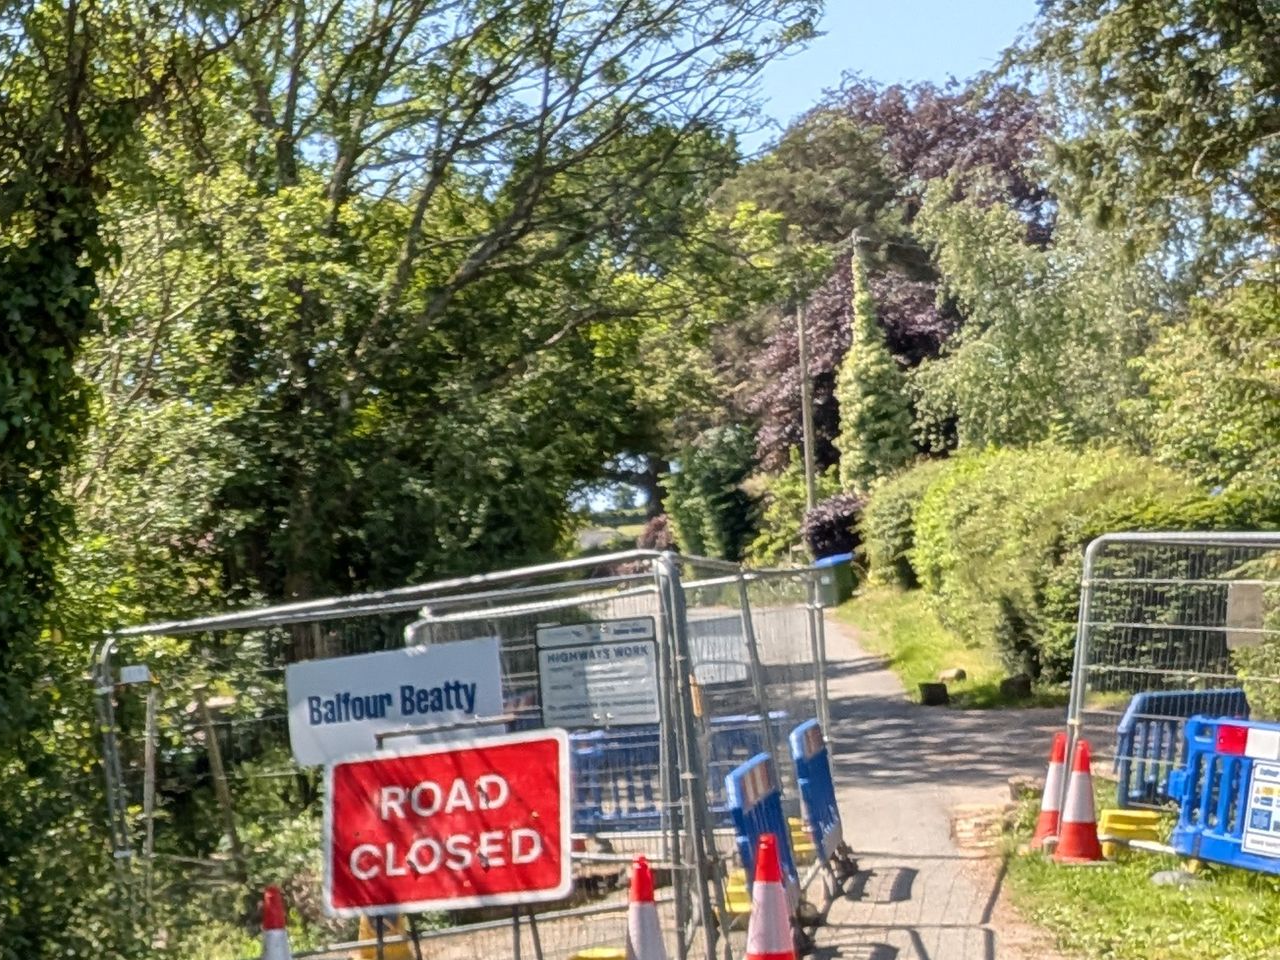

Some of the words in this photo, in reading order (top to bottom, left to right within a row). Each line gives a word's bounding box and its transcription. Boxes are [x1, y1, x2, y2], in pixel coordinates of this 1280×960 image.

[308, 692, 392, 725] Balfour
[399, 680, 476, 716] Beatty
[380, 773, 510, 820] ROAD
[349, 827, 542, 881] CLOSED
